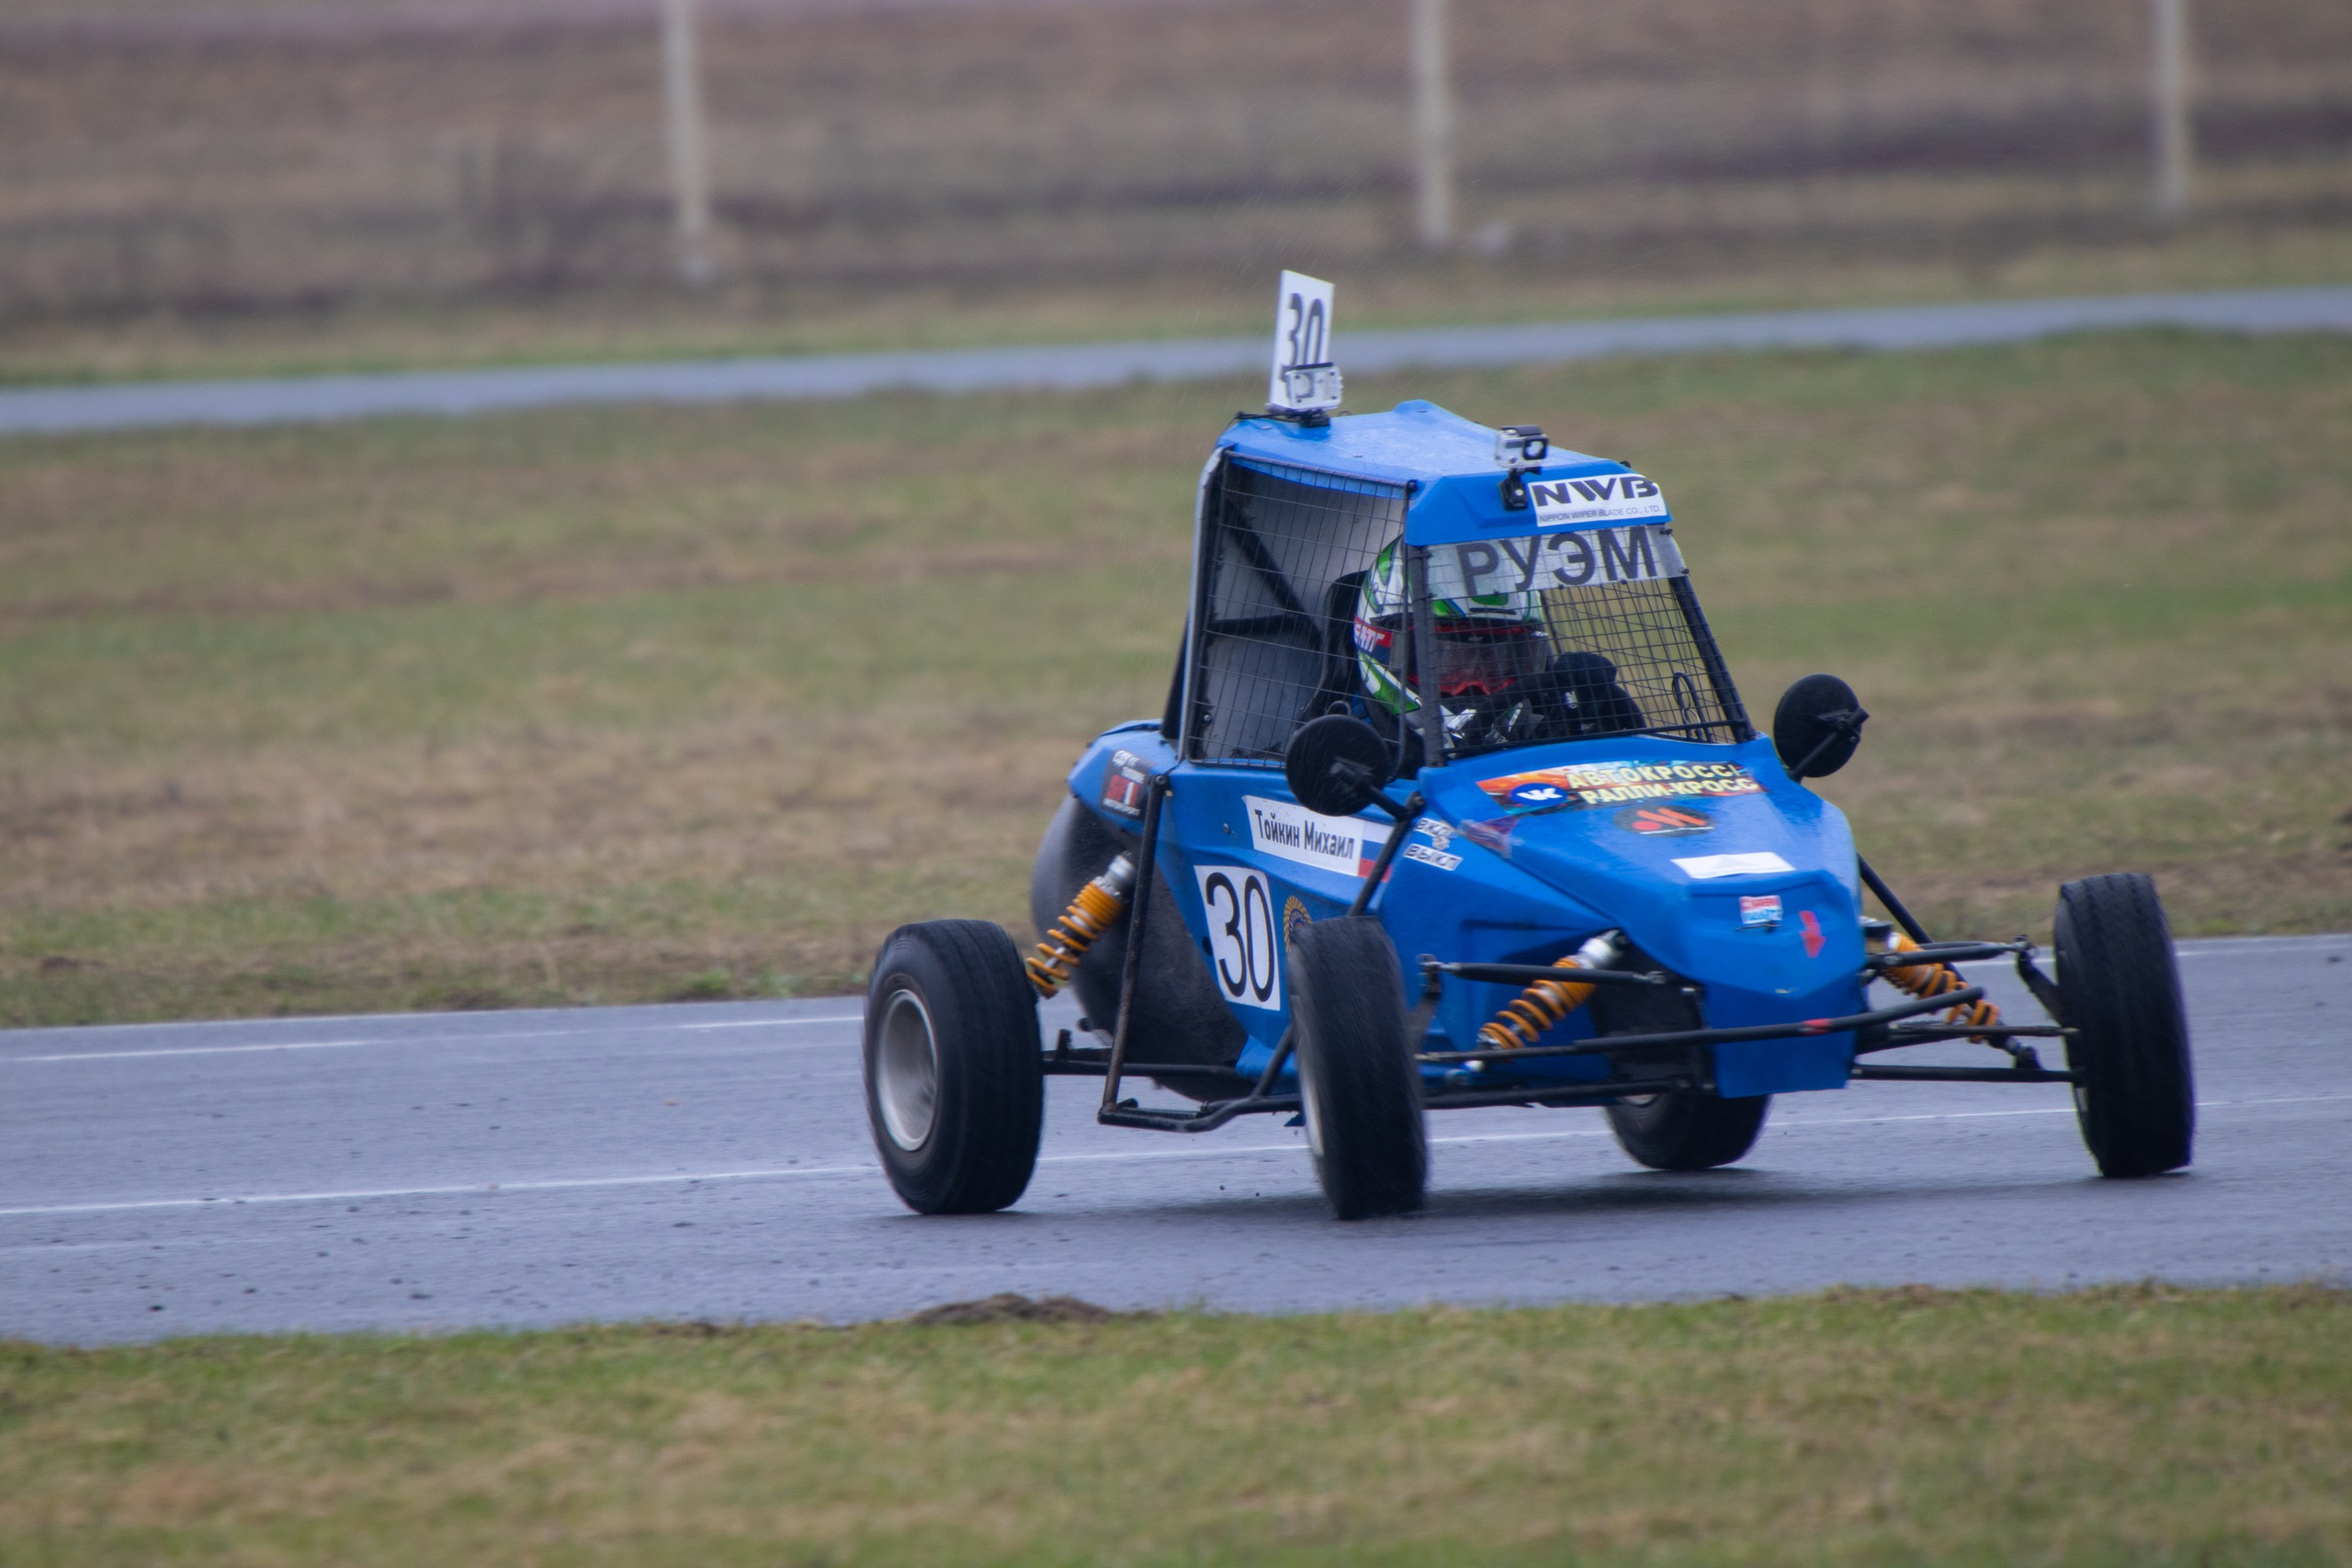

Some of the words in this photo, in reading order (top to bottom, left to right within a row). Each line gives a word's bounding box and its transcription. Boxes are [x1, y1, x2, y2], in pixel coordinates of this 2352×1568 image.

[1532, 476, 1658, 507] NWB
[1539, 513, 1570, 523] NIPPON
[1571, 509, 1597, 518] WIPER
[1598, 508, 1623, 516] BLADE
[1455, 525, 1657, 597] РУЭМ
[1577, 778, 1759, 805] РАЛЛИ-КРОСС
[1254, 809, 1300, 848] Тойкин
[1304, 819, 1355, 860] Михаил
[1205, 872, 1275, 1002] 30
